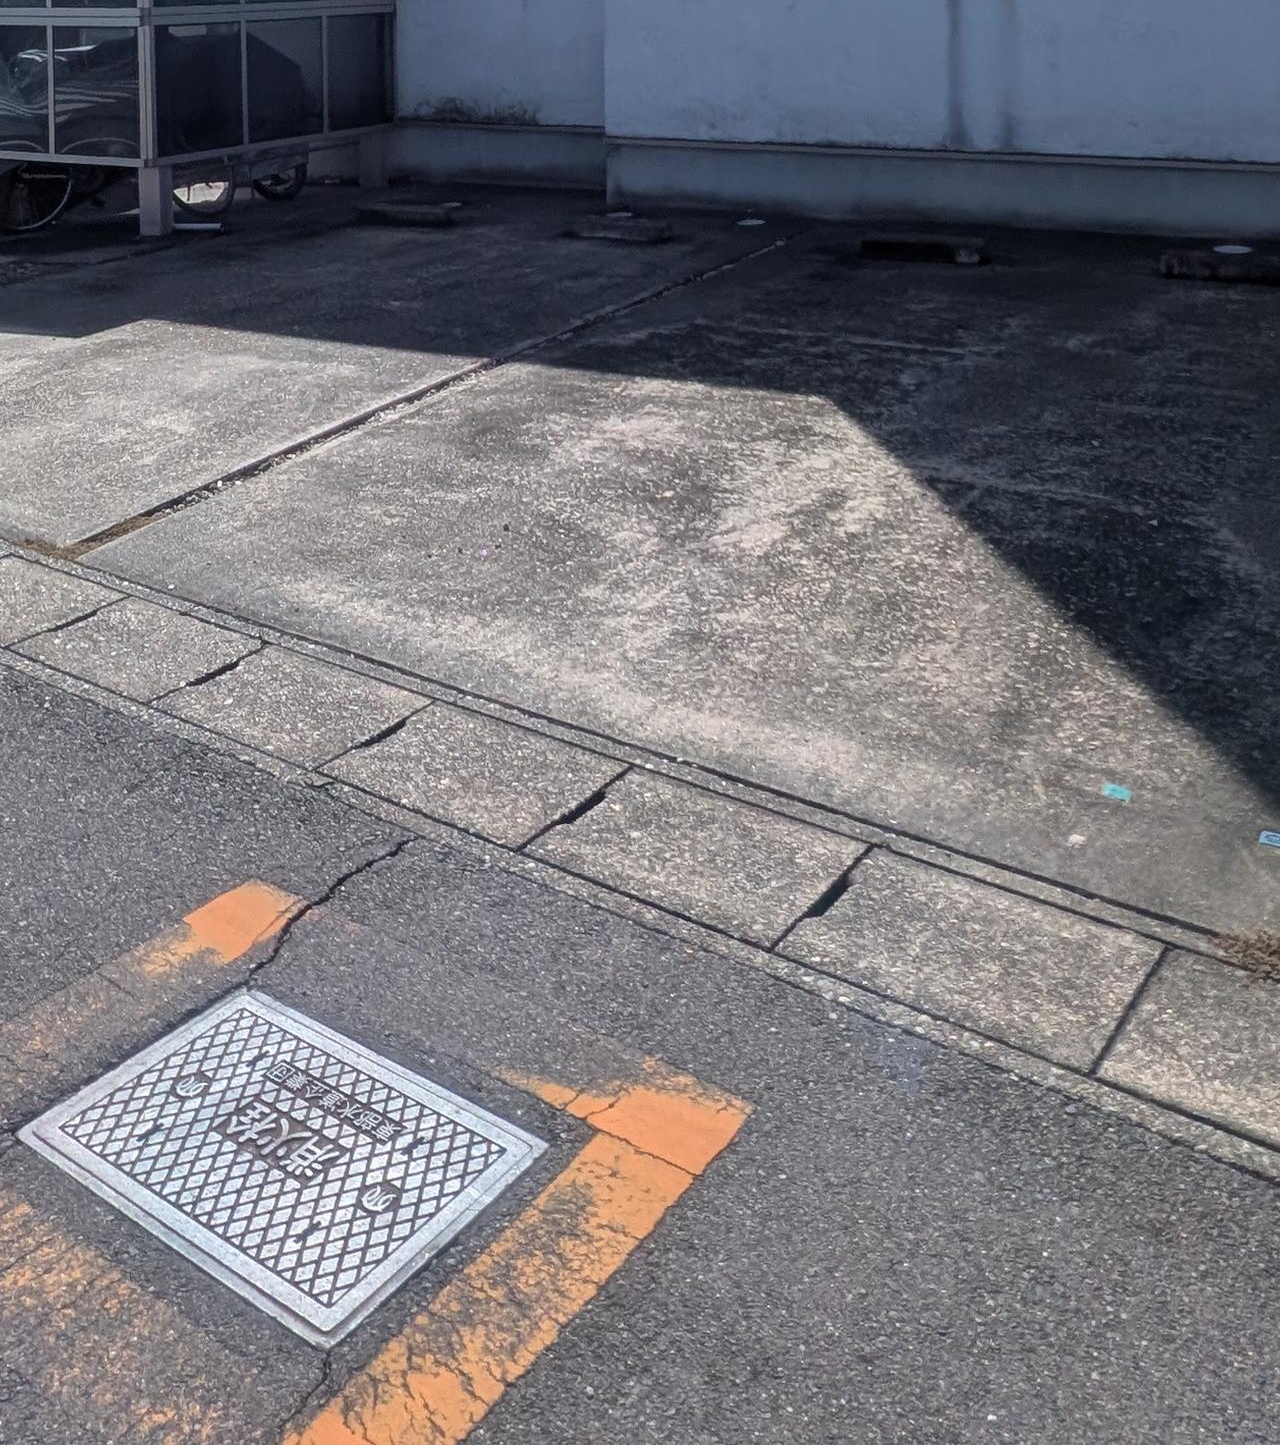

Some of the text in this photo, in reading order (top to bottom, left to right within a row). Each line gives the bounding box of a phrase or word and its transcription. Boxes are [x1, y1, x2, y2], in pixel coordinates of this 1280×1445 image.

[227, 1103, 339, 1176] 消火栓
[268, 1062, 401, 1142] 東部水道企業団
